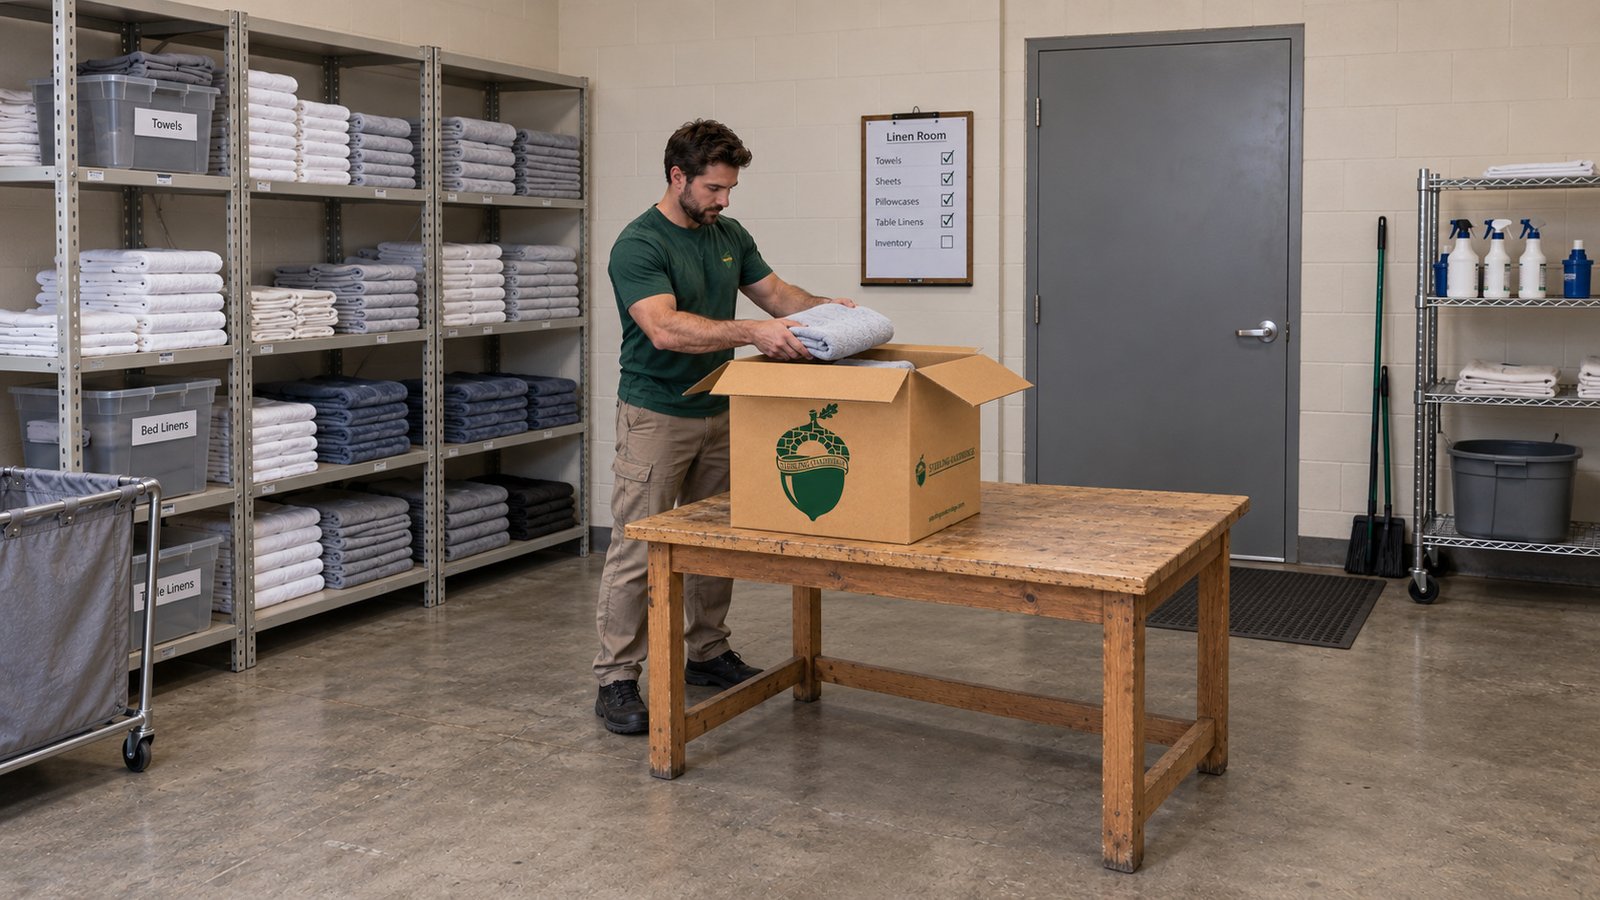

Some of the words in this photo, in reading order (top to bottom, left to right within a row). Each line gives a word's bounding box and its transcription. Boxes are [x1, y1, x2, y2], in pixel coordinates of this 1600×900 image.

[152, 118, 183, 131] Towels
[886, 131, 914, 142] Linen
[916, 131, 947, 141] Room
[875, 156, 902, 166] Towels
[875, 177, 902, 186] Sheets
[875, 197, 920, 207] Pillowcases
[875, 217, 896, 227] Table
[897, 217, 925, 227] Linens
[875, 239, 913, 250] Inventory
[141, 424, 159, 436] Bed
[161, 421, 189, 433] Linens
[140, 587, 165, 601] Tle
[167, 580, 195, 595] Linens
